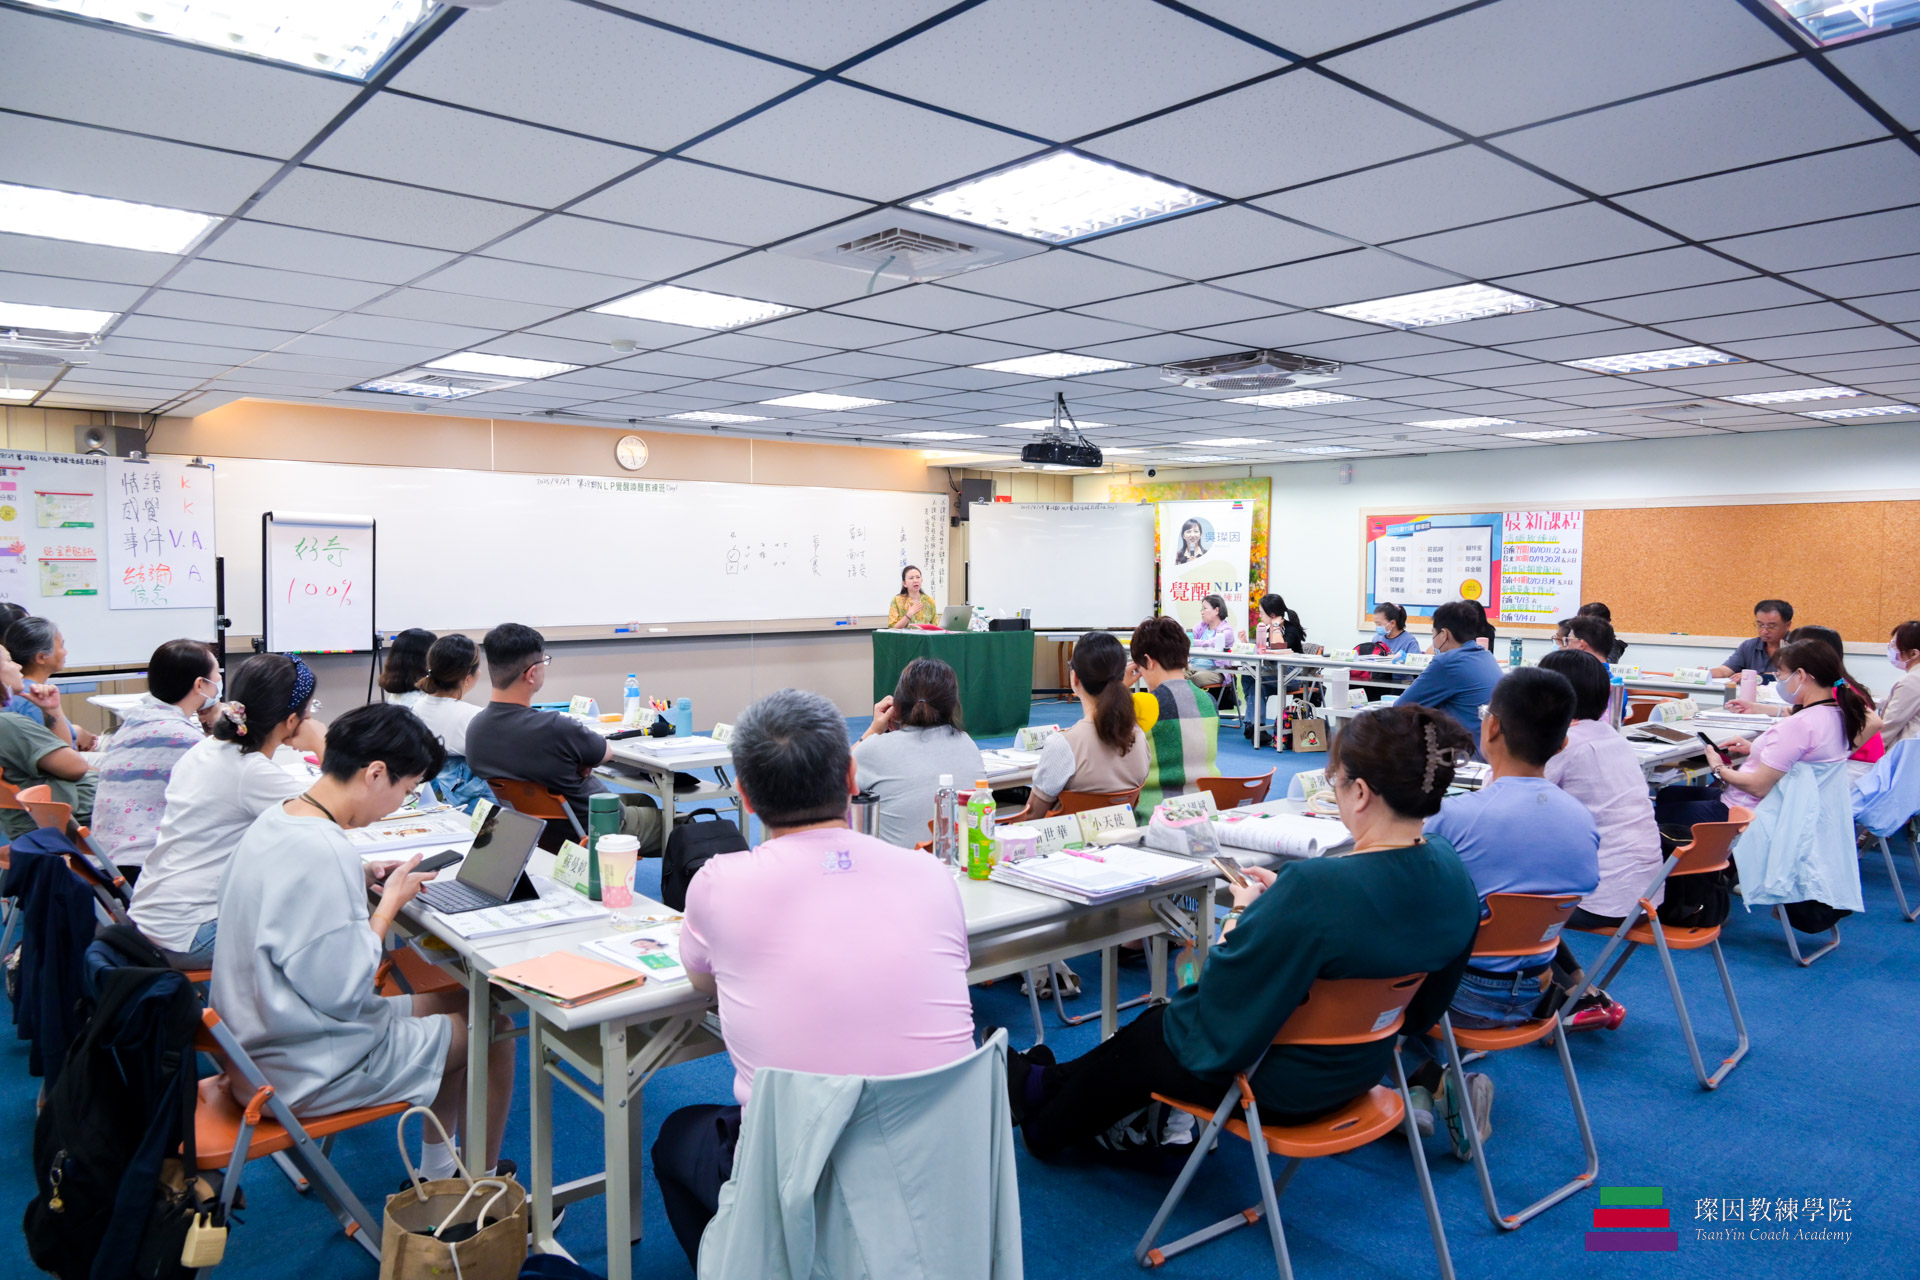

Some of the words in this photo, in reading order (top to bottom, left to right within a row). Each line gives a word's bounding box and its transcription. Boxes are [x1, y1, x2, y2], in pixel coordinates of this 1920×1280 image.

[1504, 511, 1581, 531] 最新課程
[288, 578, 352, 606] 100%
[1169, 581, 1212, 602] 覺醒
[1214, 582, 1243, 592] NLP
[1093, 813, 1125, 831] 小天使
